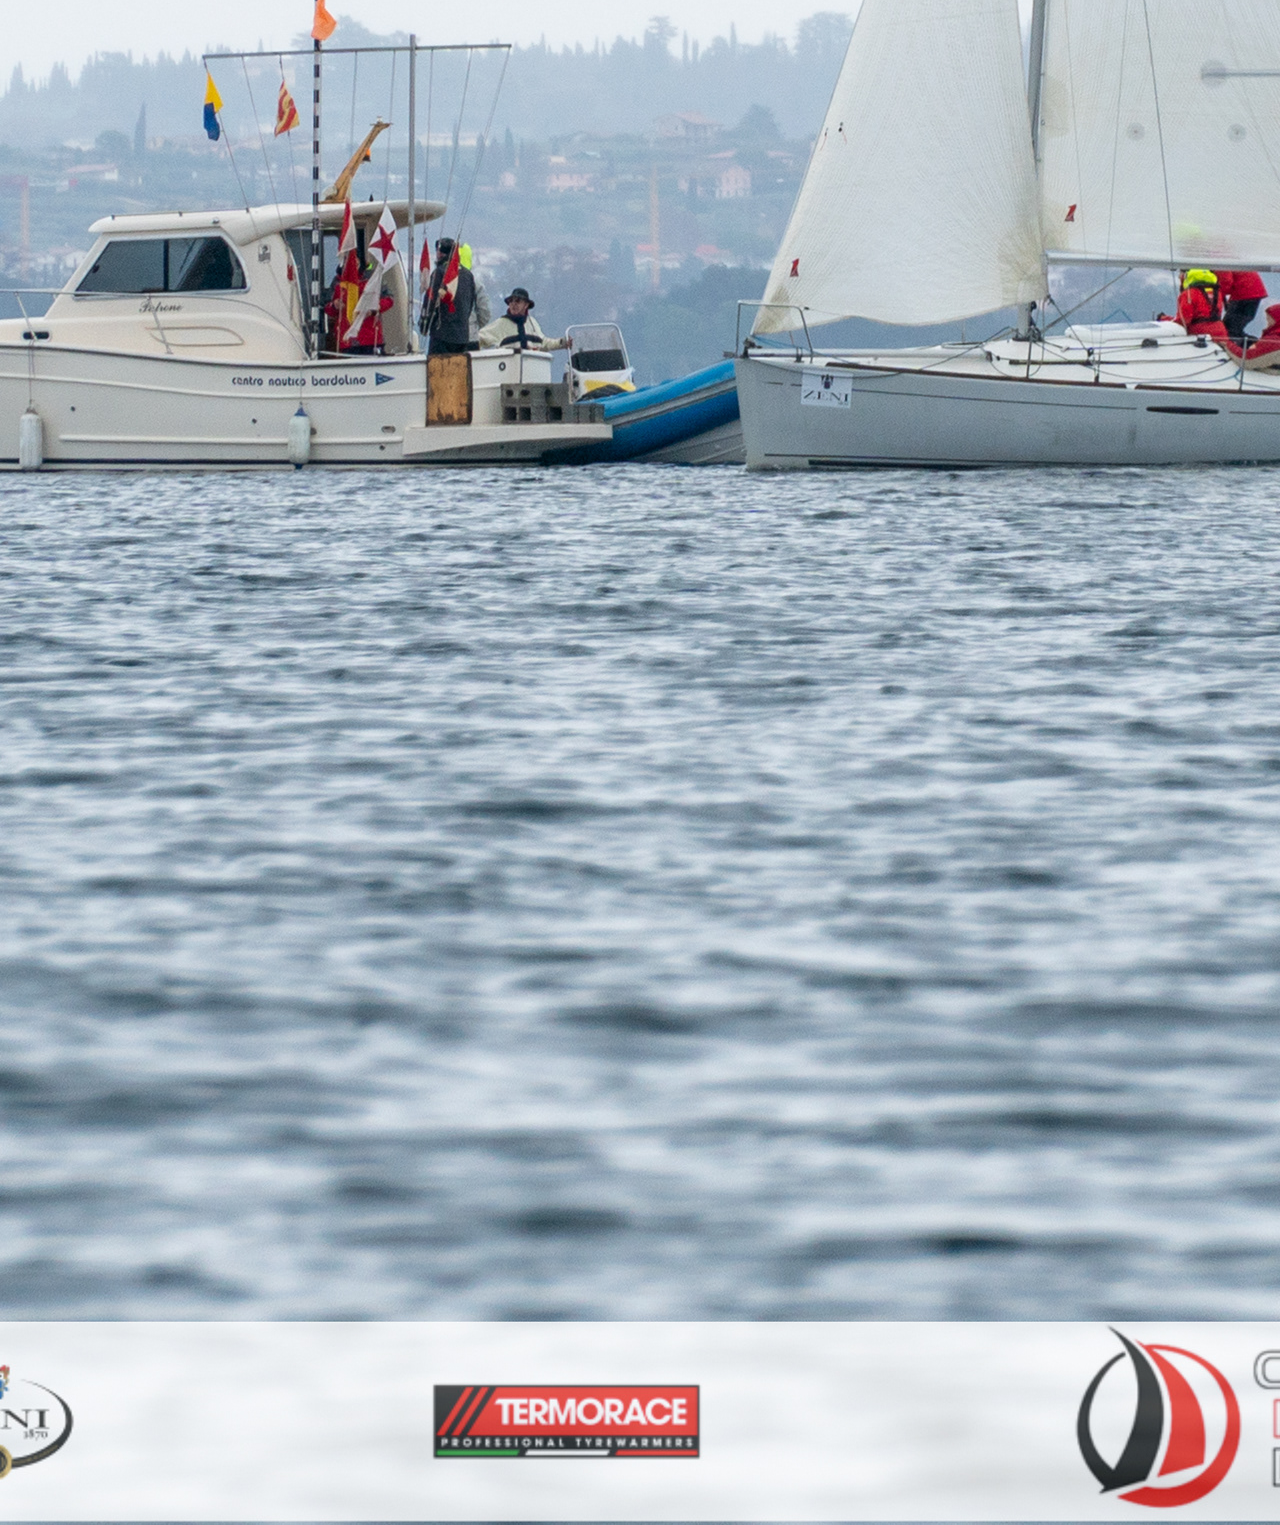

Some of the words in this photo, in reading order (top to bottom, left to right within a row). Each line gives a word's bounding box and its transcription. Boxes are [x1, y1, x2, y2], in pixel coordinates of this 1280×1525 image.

[231, 376, 264, 387] centro
[268, 376, 307, 387] nautico
[311, 375, 367, 387] bardolino
